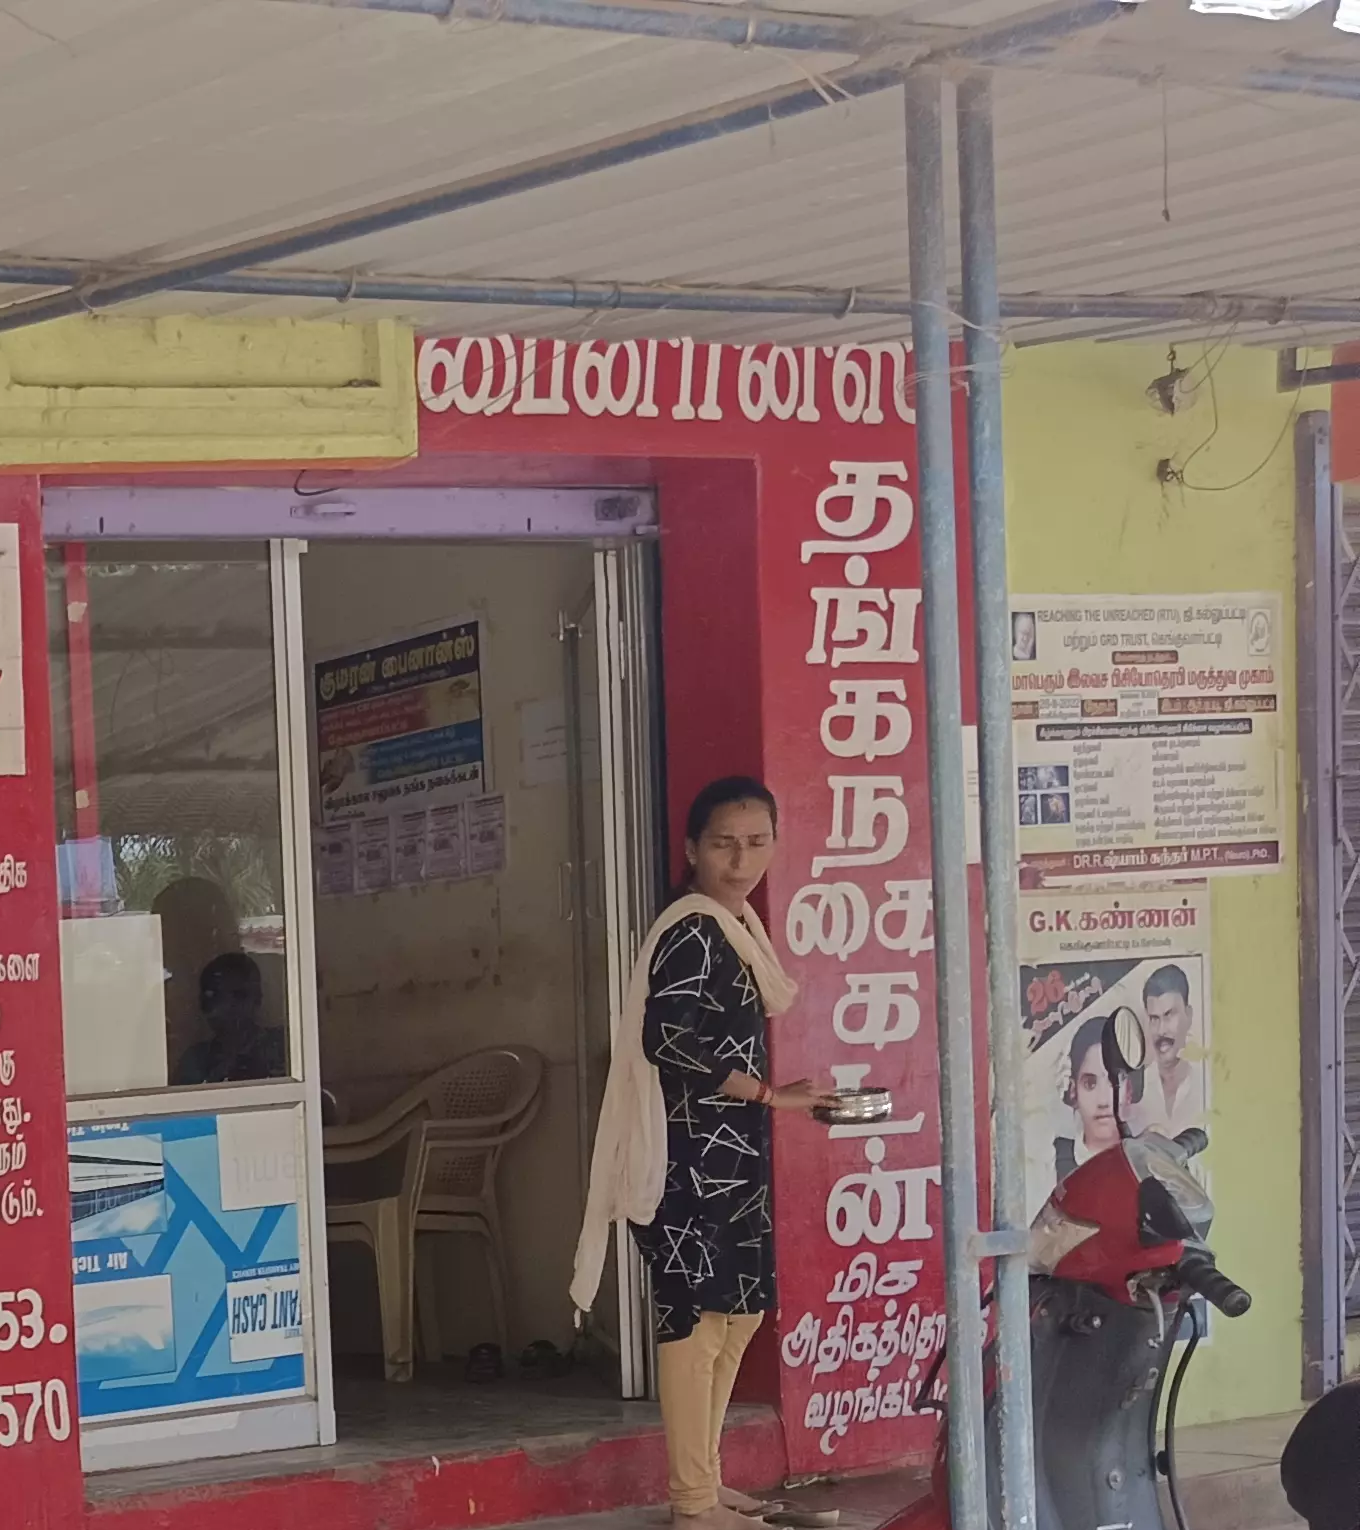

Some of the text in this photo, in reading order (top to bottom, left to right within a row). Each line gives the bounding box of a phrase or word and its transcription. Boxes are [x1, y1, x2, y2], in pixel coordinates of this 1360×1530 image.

[1037, 609, 1081, 623] REACHING
[1084, 609, 1101, 622] THE
[1102, 608, 1155, 622] UNREACHED
[1067, 667, 1108, 689] இலவச
[73, 1251, 128, 1275] Air Tic
[826, 1251, 924, 1303] மிக
[231, 1289, 302, 1335] TANT CASH
